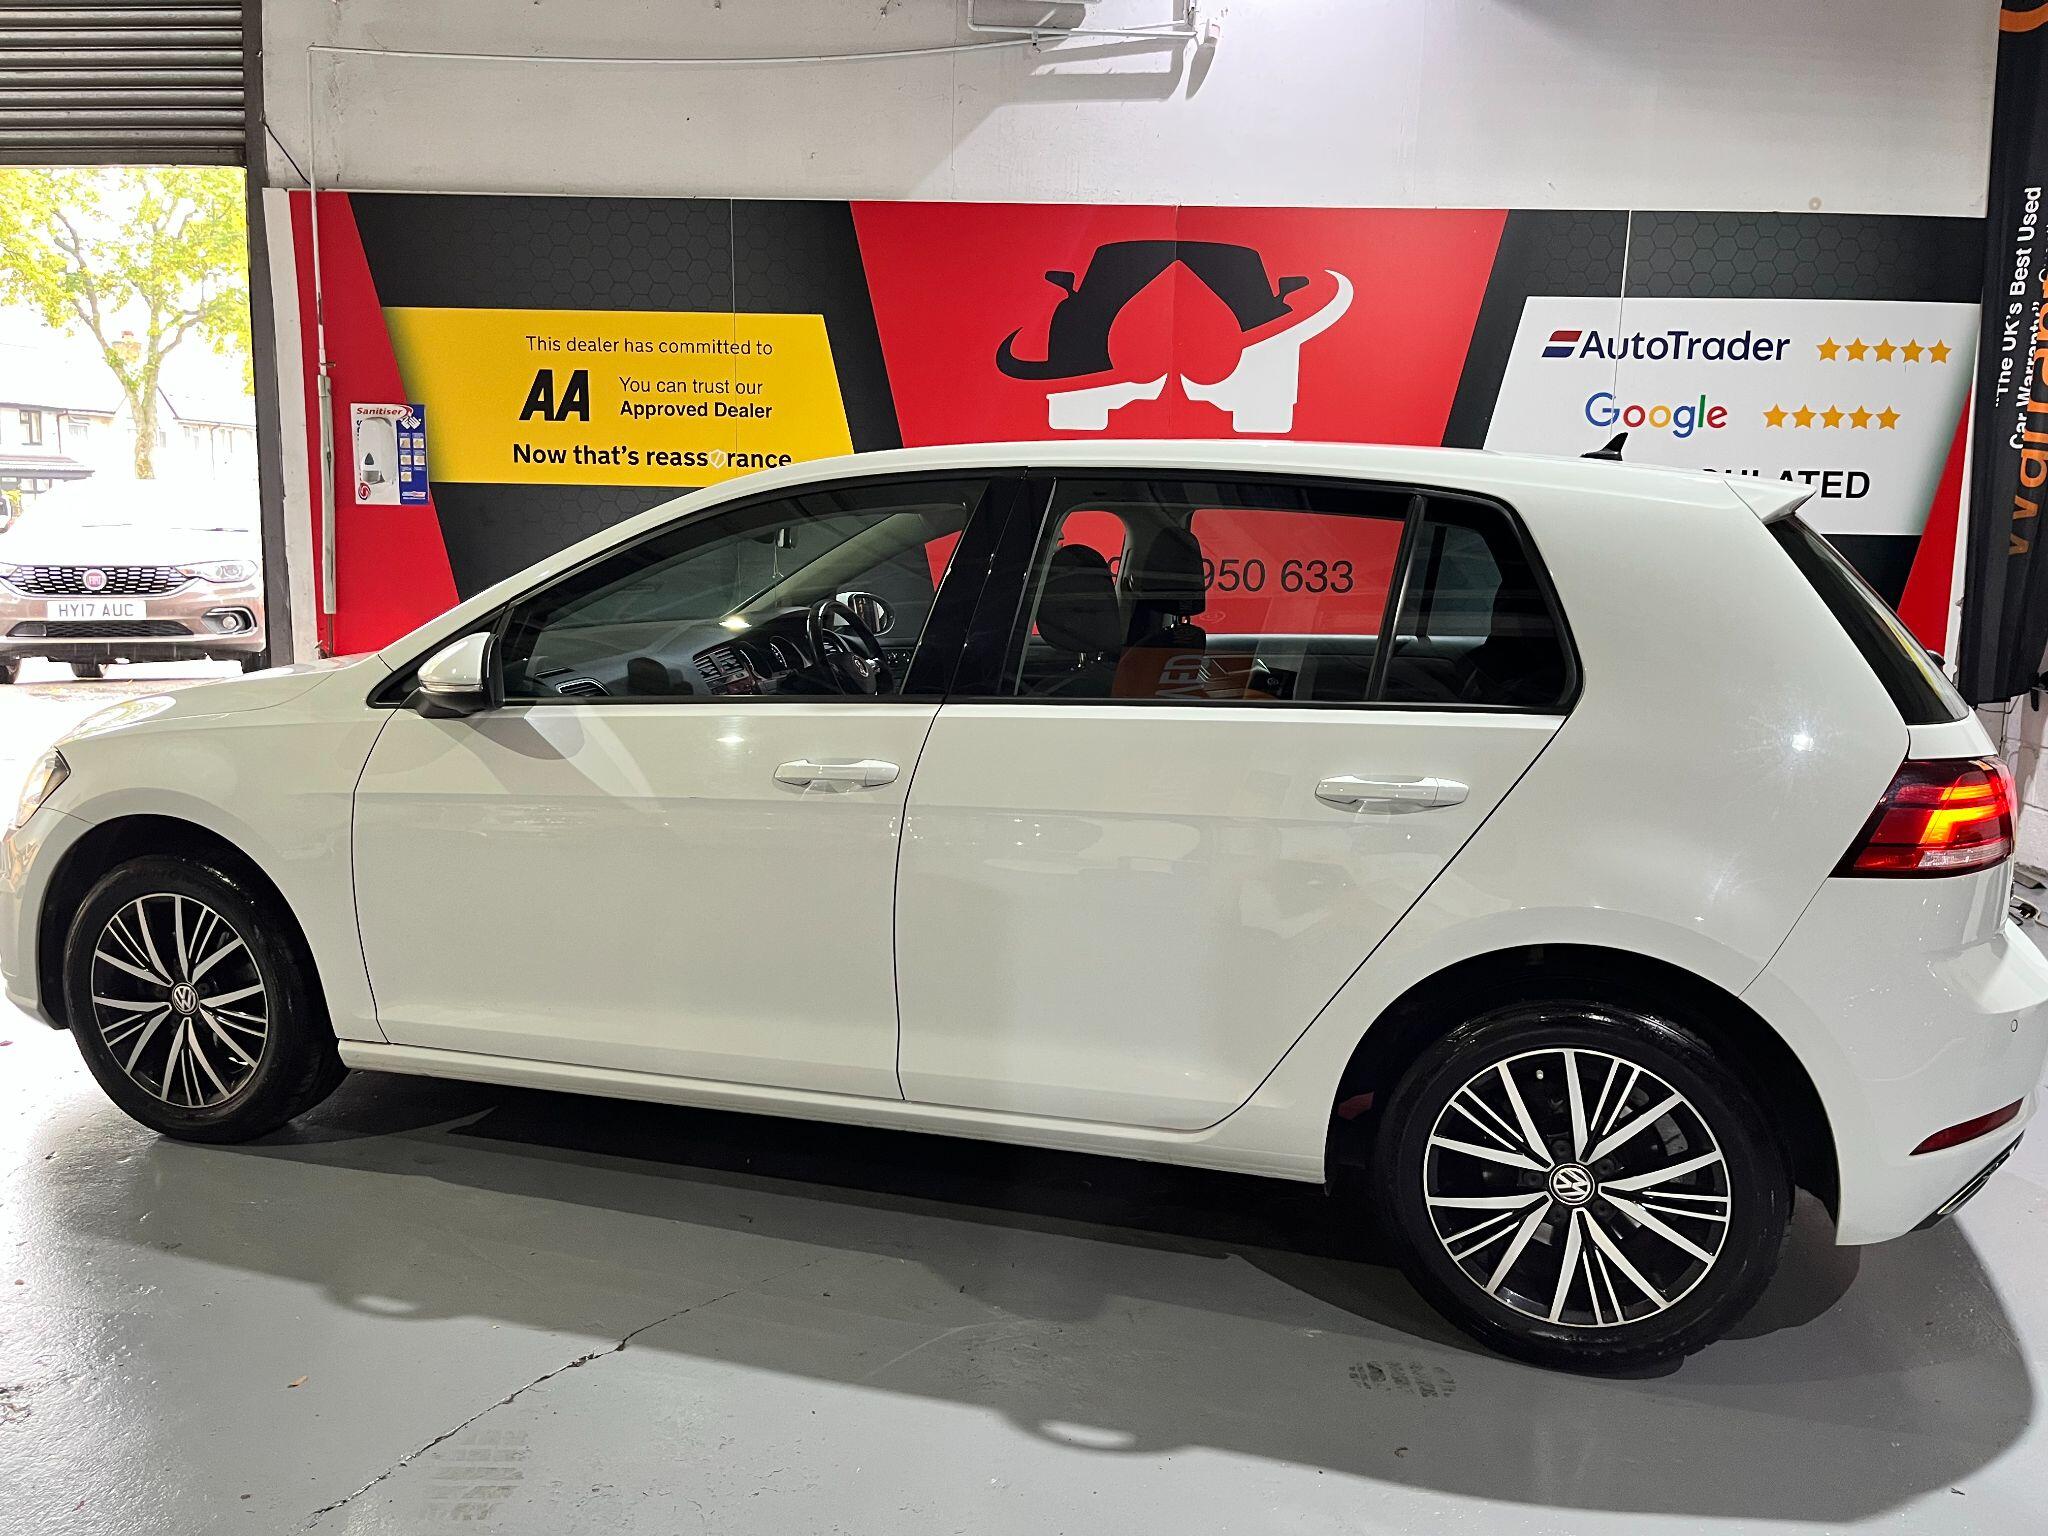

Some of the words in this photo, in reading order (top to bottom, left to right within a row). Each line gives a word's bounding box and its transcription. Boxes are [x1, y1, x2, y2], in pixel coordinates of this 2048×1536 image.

[2017, 186, 2042, 242] Used
[2009, 247, 2032, 296] Best
[2002, 302, 2023, 351] UK’s
[526, 335, 561, 352] This
[567, 337, 619, 353] dealer
[624, 338, 654, 354] has
[658, 339, 751, 355] committed
[756, 341, 773, 356] to
[1580, 330, 1790, 362] AutoTrader
[519, 369, 590, 422] AA
[619, 377, 651, 393] You
[656, 379, 687, 393] can
[692, 379, 730, 394] trust
[735, 381, 763, 395] our
[356, 407, 403, 415] Sanitiser
[620, 400, 708, 419] Approved
[714, 402, 773, 418] Dealer
[1585, 392, 1728, 438] Google
[513, 443, 567, 464] Now
[573, 445, 640, 465] that’s
[1280, 559, 1354, 593] 633
[58, 604, 95, 617] HY17
[102, 604, 135, 617] AUC
